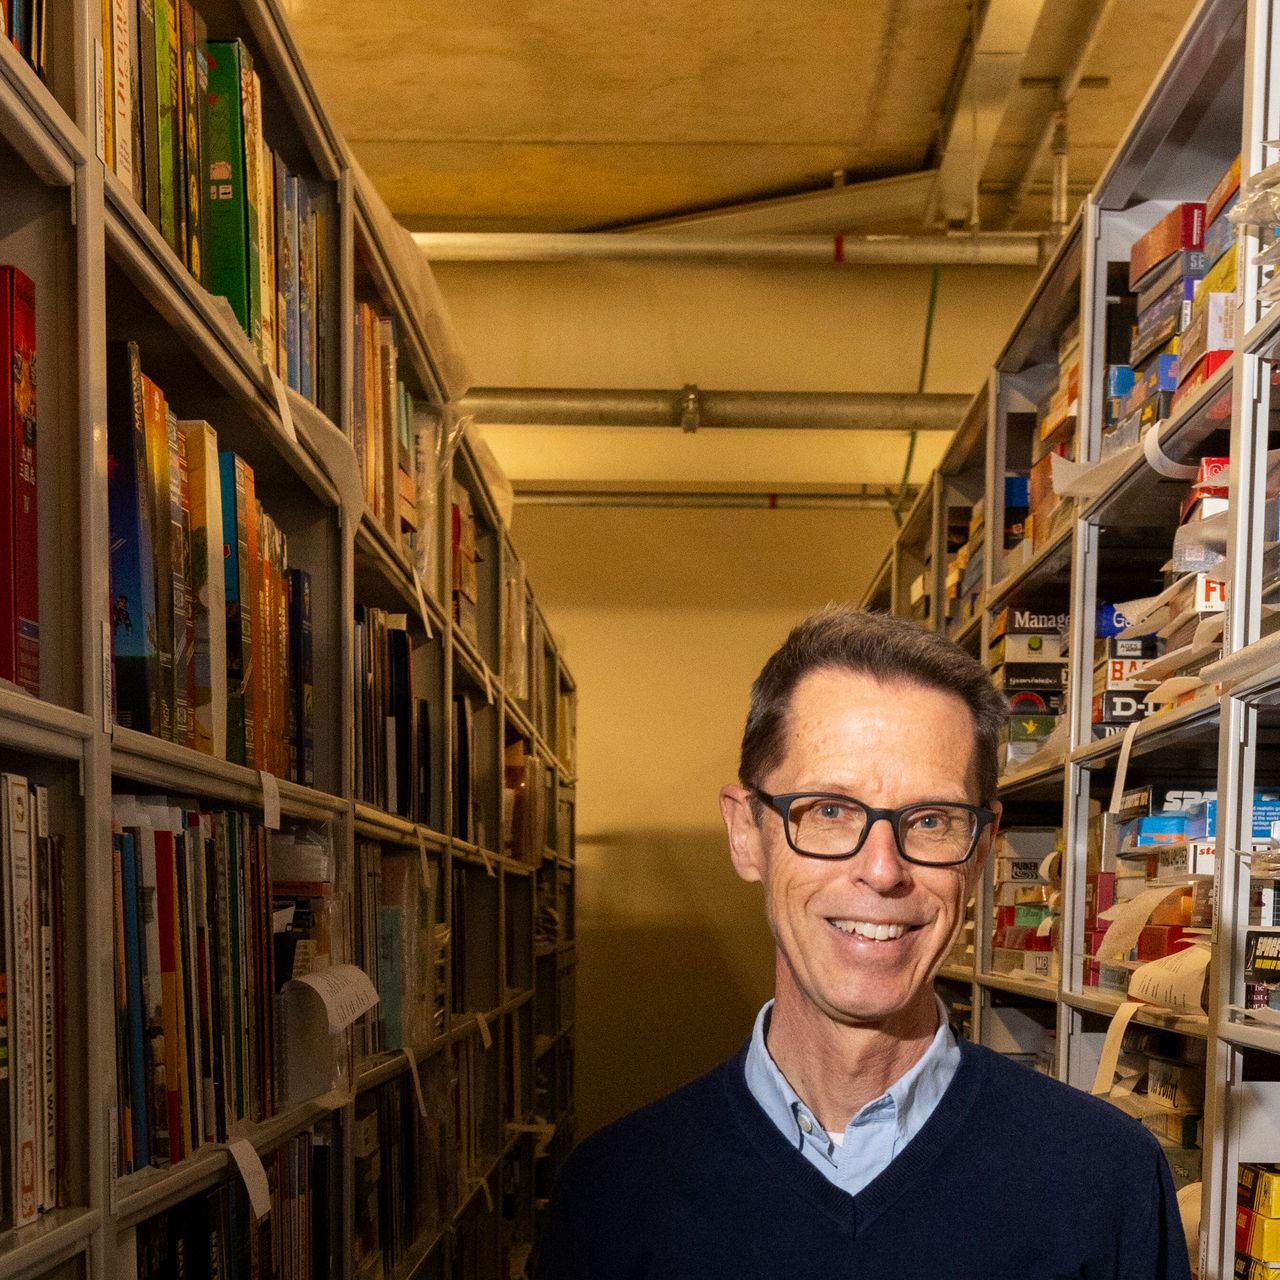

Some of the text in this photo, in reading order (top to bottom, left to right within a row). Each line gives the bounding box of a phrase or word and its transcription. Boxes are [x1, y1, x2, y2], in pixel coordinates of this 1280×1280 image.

[43, 943, 56, 1138] THE FOREVER WAR
